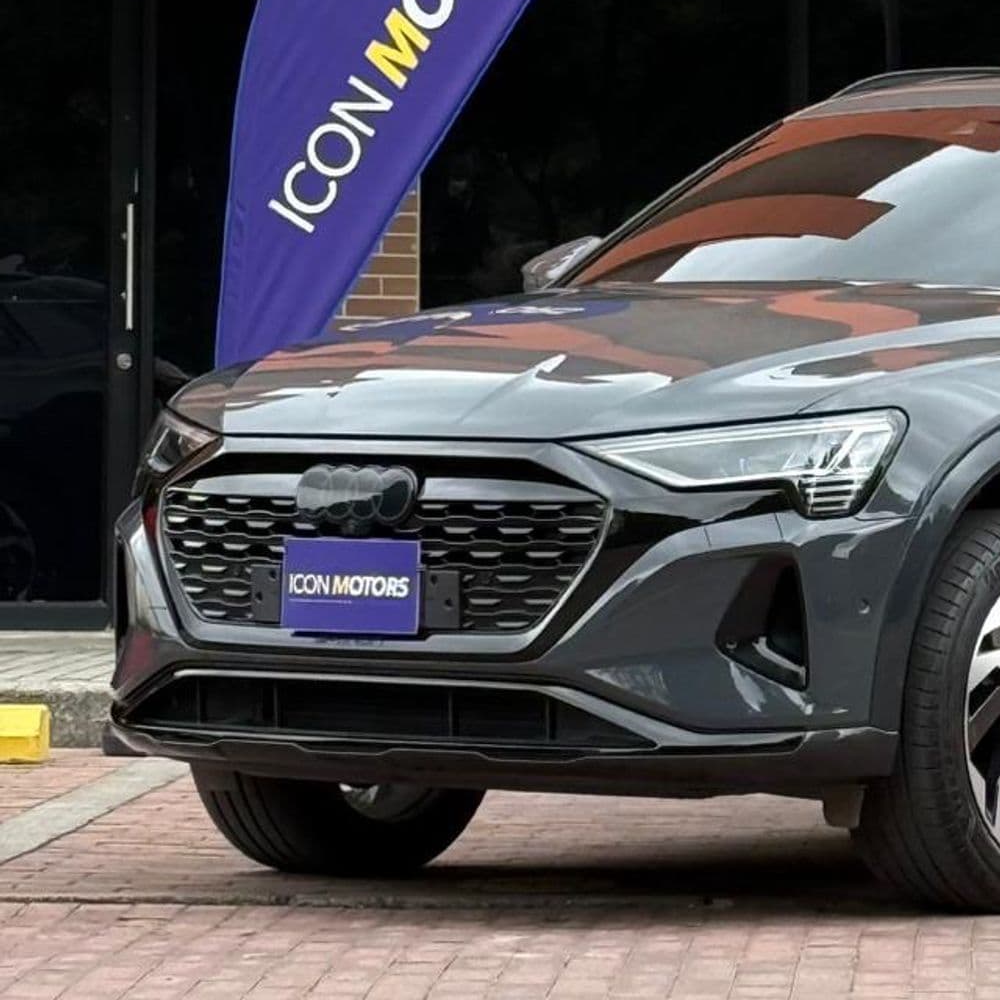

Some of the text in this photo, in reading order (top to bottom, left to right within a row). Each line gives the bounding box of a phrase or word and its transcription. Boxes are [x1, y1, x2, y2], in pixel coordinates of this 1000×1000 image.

[268, 76, 393, 233] ICON
[289, 573, 410, 598] ICON MOTORS
